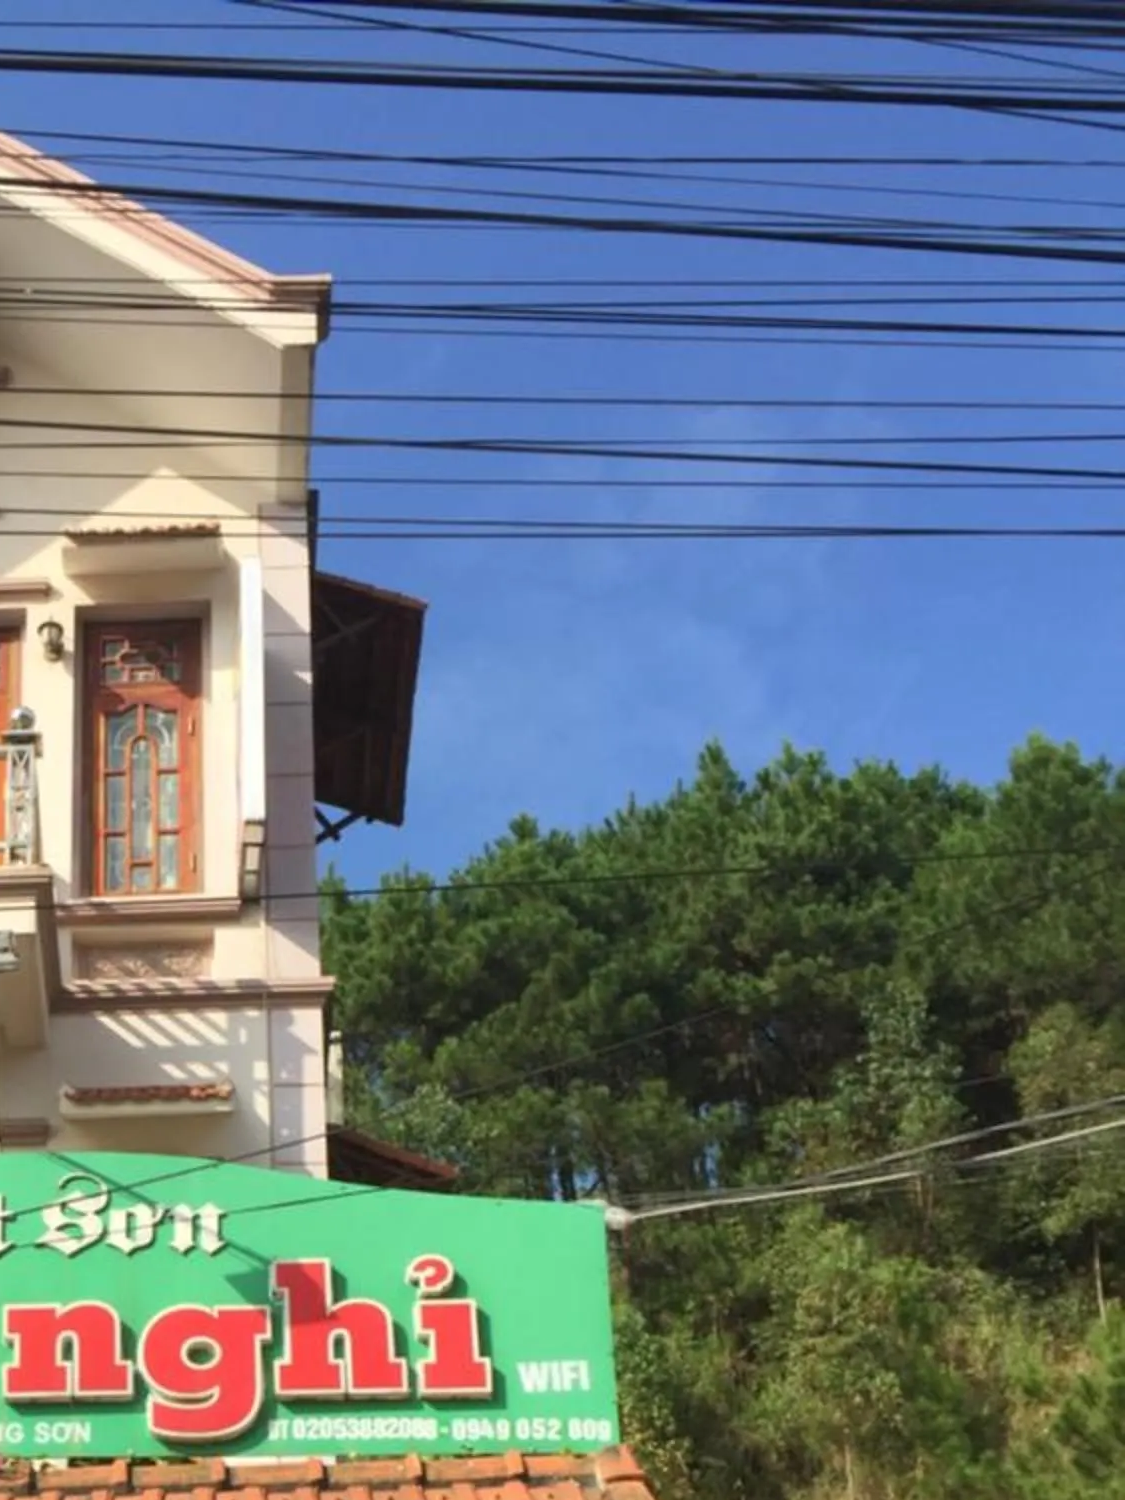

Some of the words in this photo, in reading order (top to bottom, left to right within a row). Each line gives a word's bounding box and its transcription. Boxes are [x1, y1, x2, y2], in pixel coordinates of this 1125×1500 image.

[36, 1172, 228, 1256] Sơn
[1, 1254, 493, 1443] nghỉ
[516, 1359, 590, 1393] WIFI
[34, 1421, 92, 1444] SƠN
